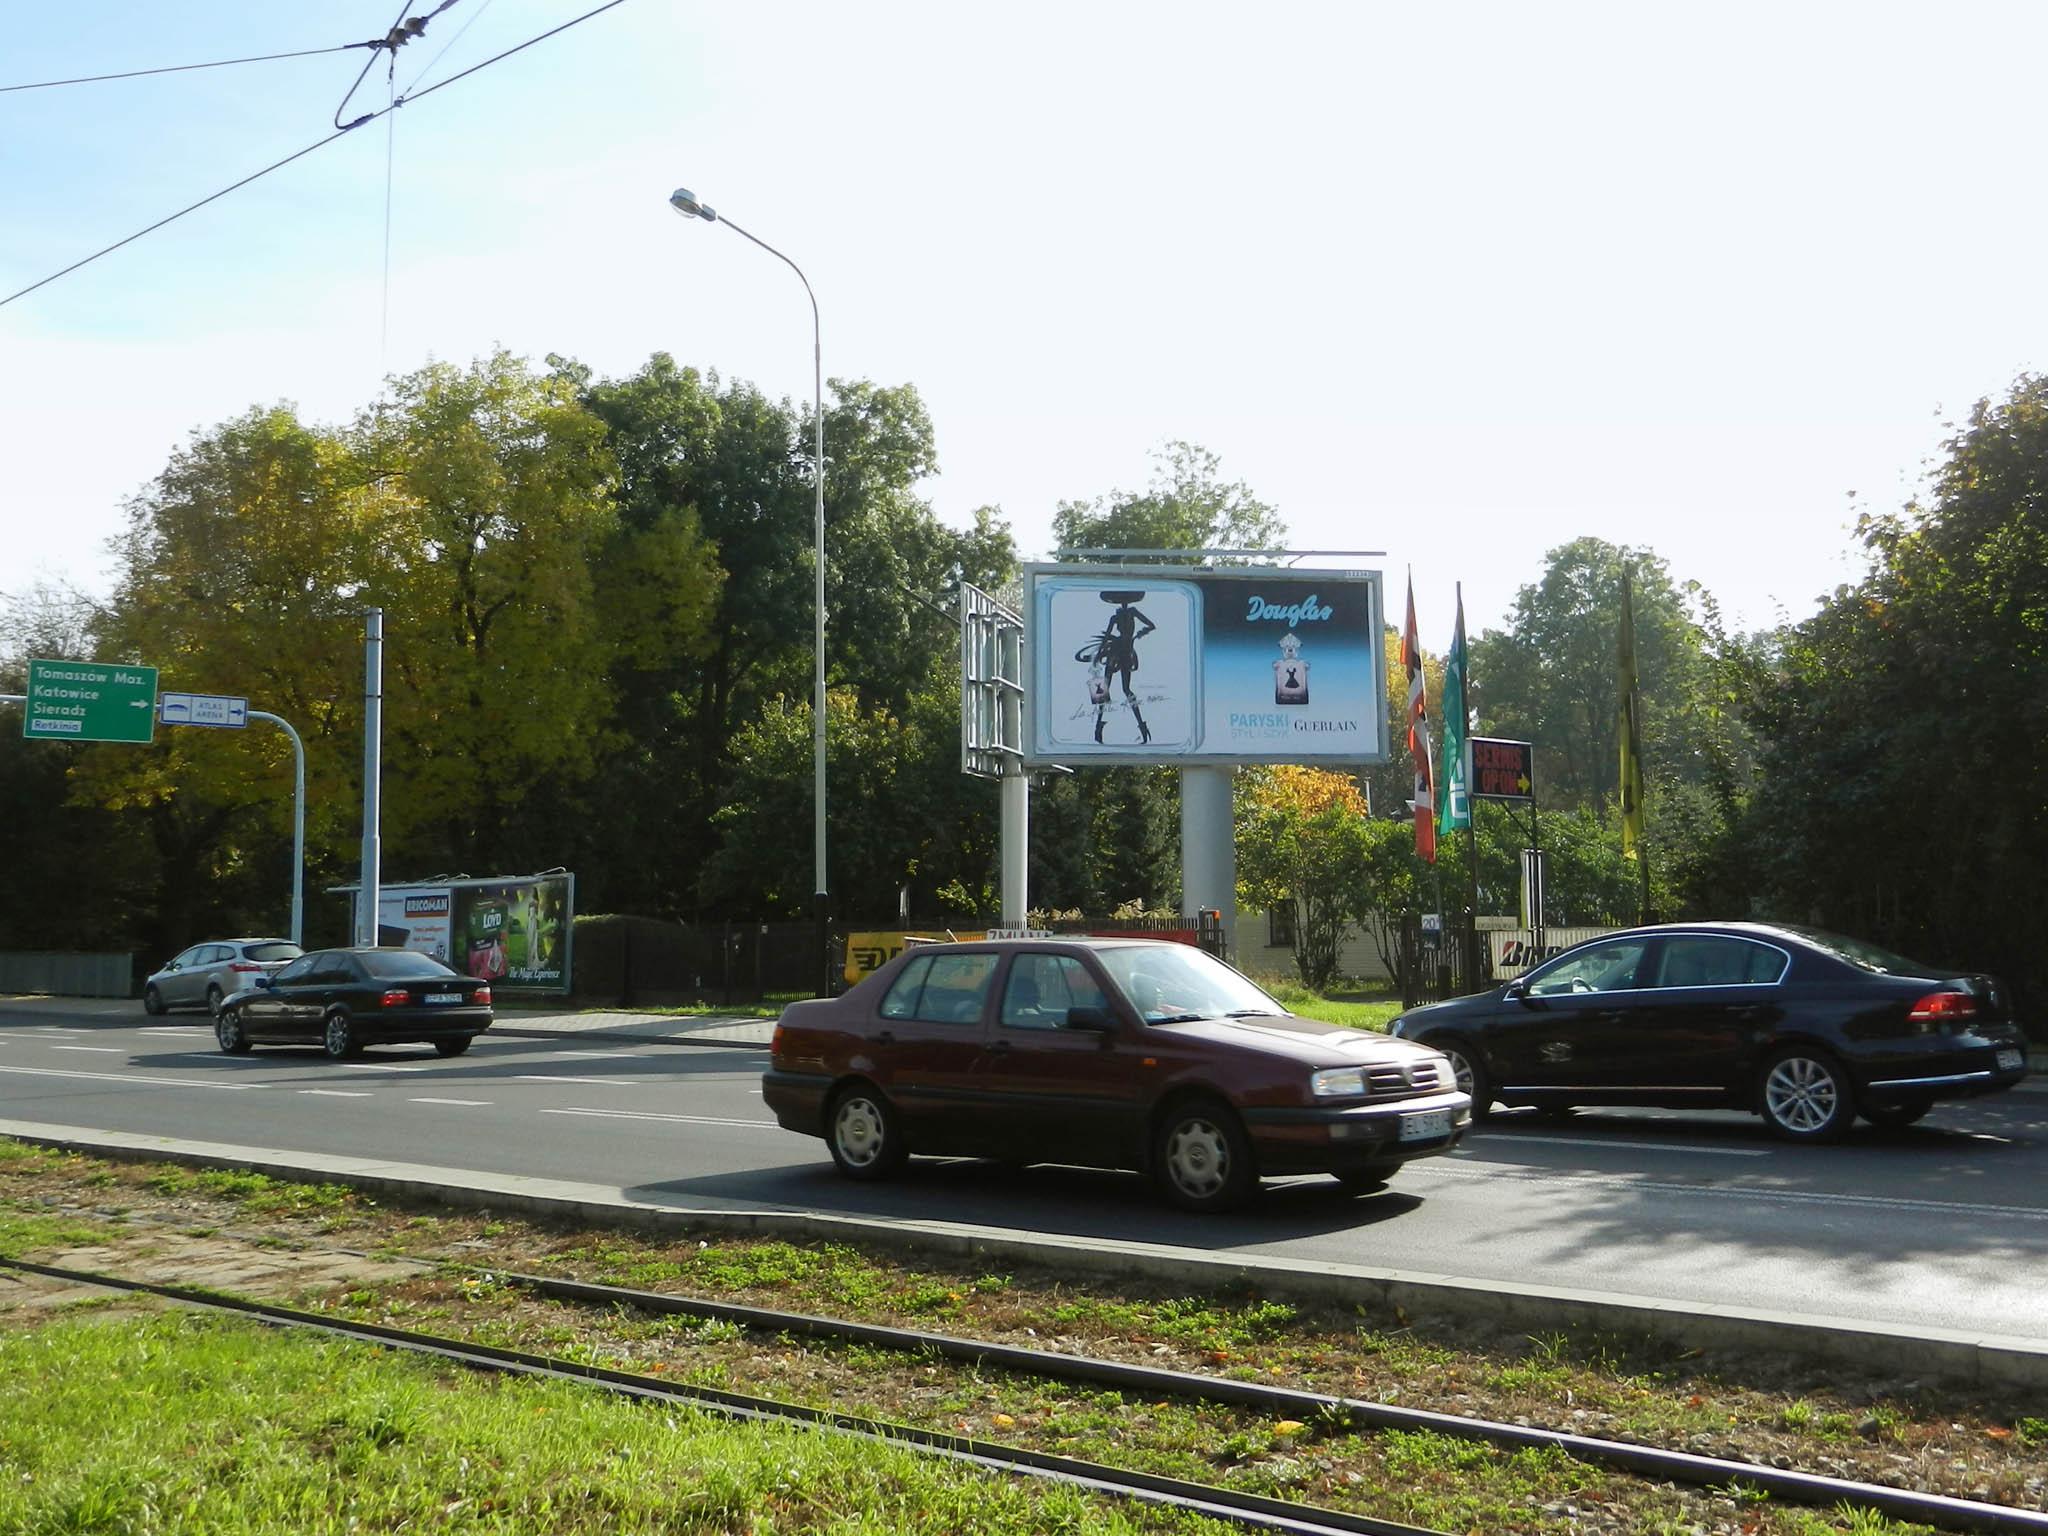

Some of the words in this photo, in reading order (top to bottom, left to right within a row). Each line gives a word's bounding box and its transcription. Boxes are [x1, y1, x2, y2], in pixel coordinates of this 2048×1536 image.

[1246, 594, 1334, 628] Douglas
[36, 666, 108, 682] Tomaszów
[114, 672, 146, 685] Maz.
[34, 685, 99, 700] Katowice
[33, 702, 86, 716] Sieradz
[34, 720, 80, 731] Retkinia
[1230, 713, 1289, 727] PARYSKI
[1294, 719, 1358, 732] GUERLAIN
[483, 912, 502, 929] LOYD
